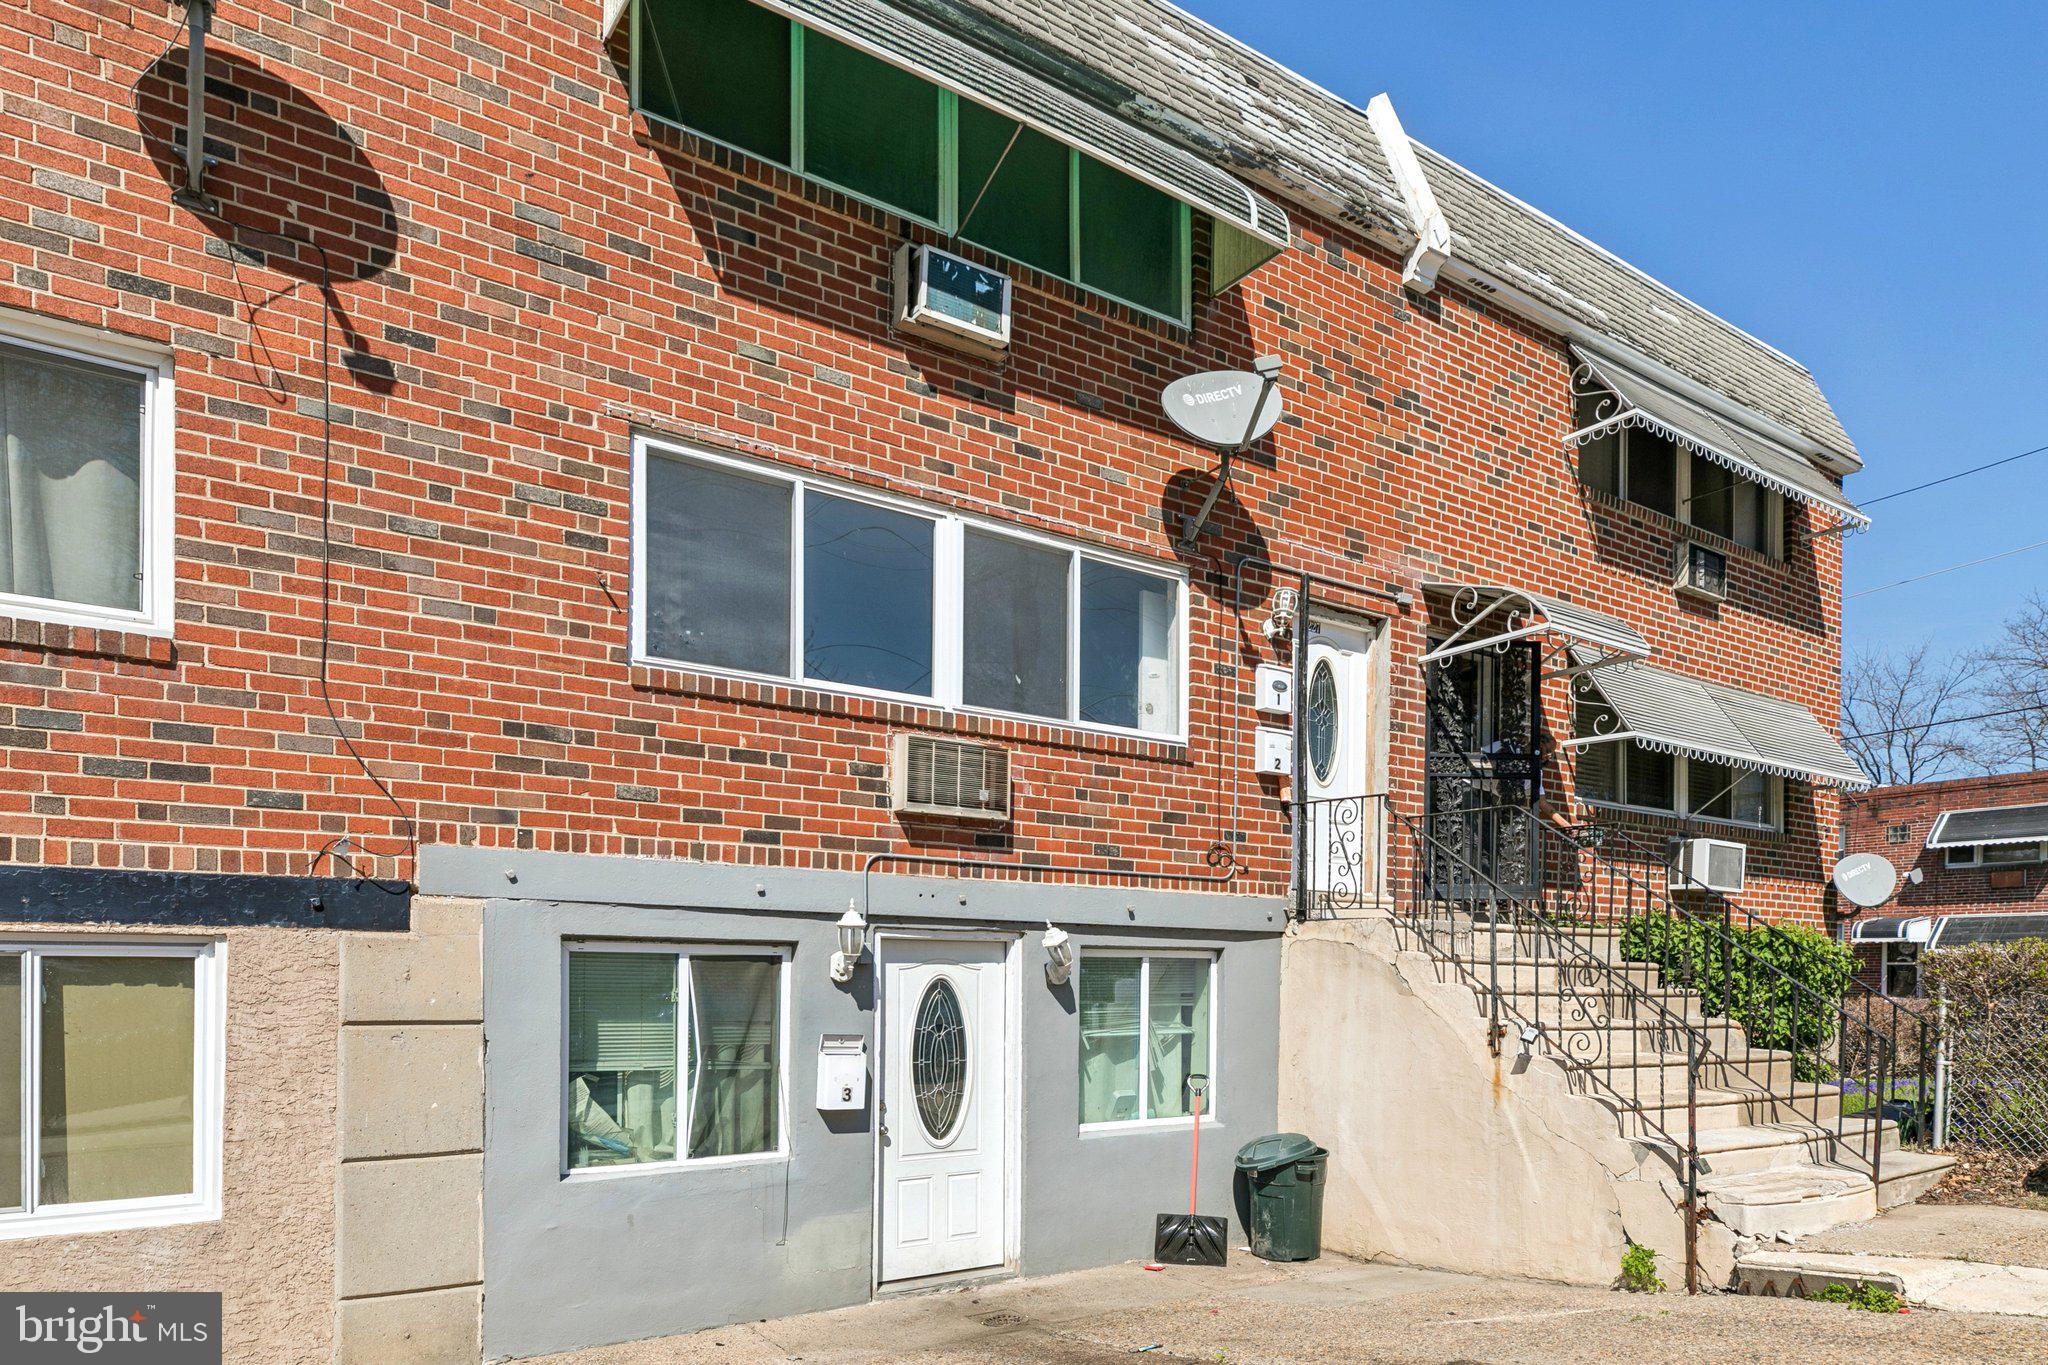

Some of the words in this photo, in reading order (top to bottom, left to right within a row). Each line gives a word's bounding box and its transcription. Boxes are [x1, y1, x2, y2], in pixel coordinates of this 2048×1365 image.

[1195, 384, 1242, 405] DIRECTV
[1274, 758, 1281, 770] 2
[842, 1087, 852, 1102] 3
